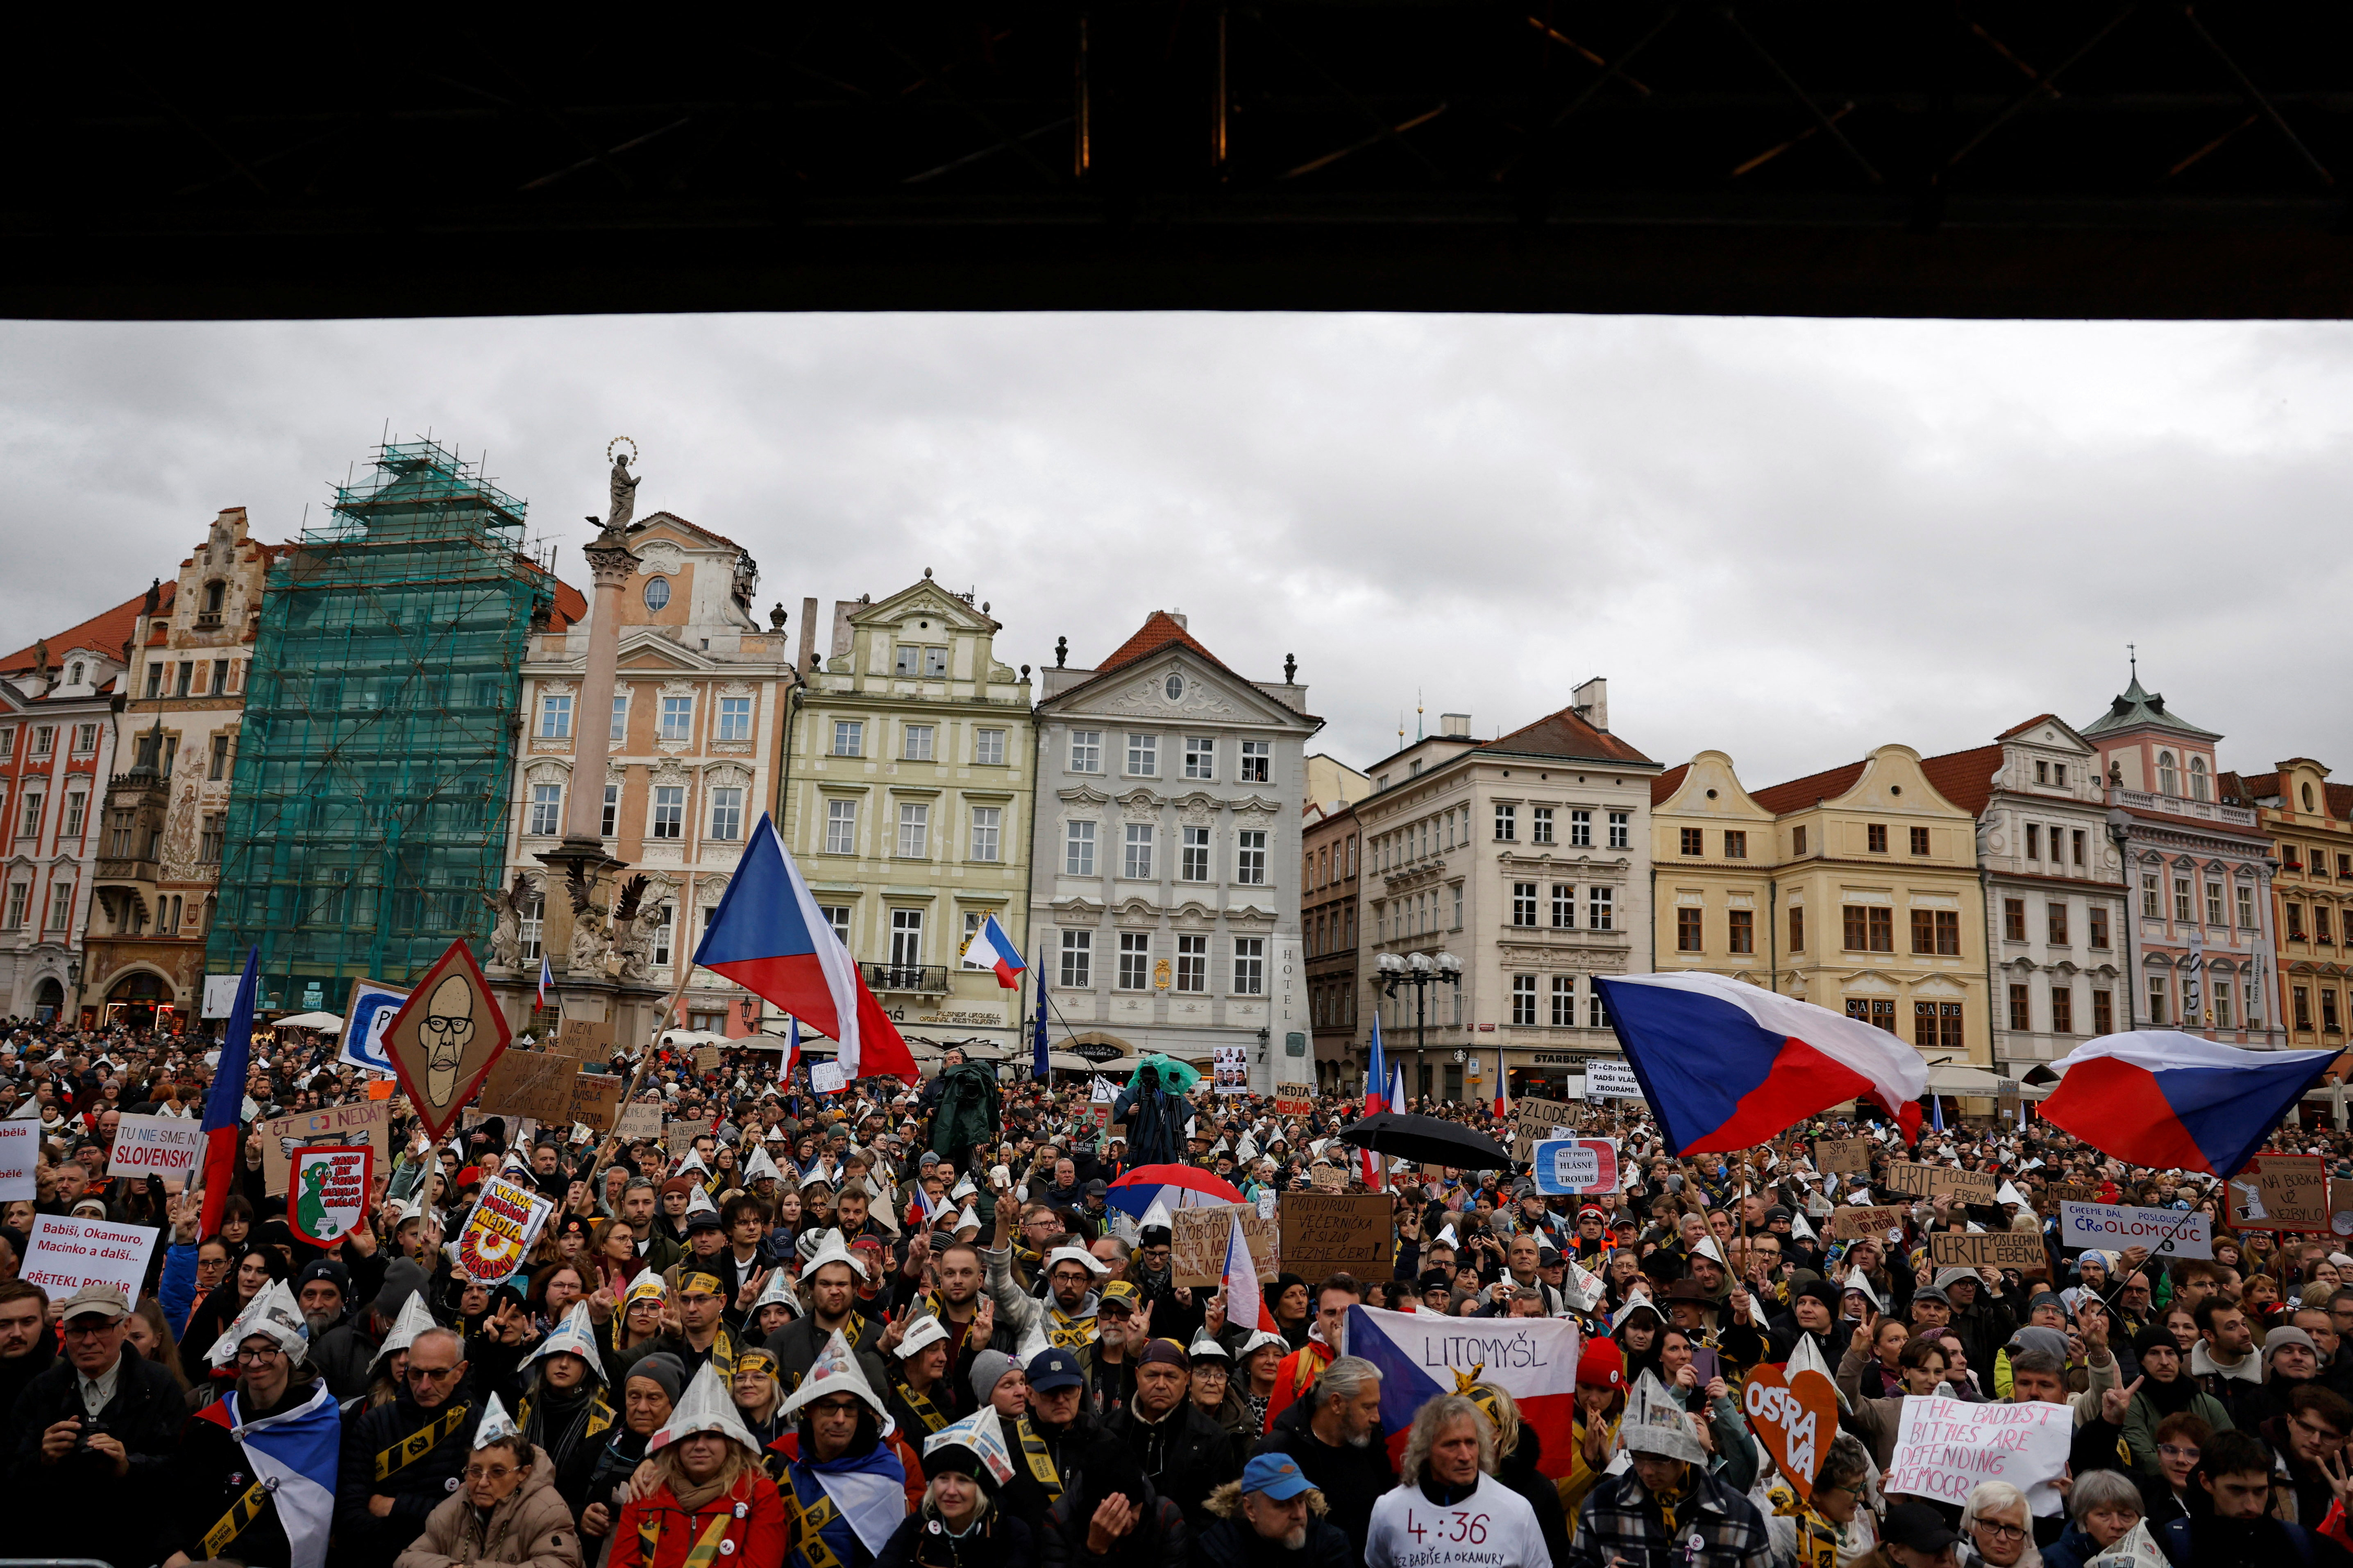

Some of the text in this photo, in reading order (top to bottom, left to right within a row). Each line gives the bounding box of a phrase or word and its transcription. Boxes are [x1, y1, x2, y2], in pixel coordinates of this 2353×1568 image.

[1284, 949, 1292, 1020] HOTEL
[1847, 1000, 1893, 1013] CAFE
[1915, 1004, 1960, 1016] CAFE
[570, 1022, 596, 1036] NENÍ
[506, 1052, 533, 1072] STOP
[814, 1063, 840, 1076] MÉDIA
[512, 1074, 563, 1091] AROGANCE
[591, 1078, 615, 1090] 404
[816, 1083, 824, 1092] NE
[1277, 1082, 1311, 1097] MÉDIA
[1596, 1085, 1637, 1094] ZBOURÁME!
[1276, 1097, 1310, 1115] NEDÁME
[1523, 1101, 1577, 1126] ZLODĚJ
[120, 1126, 184, 1144] TU NIE SME
[272, 1119, 295, 1137] ČT
[617, 1123, 638, 1132] DOBRO
[1829, 1142, 1848, 1155] SPD
[334, 1166, 352, 1176] BY
[1560, 1160, 1593, 1169] HLÁSNÉ
[330, 1175, 362, 1186] TOHO
[1313, 1171, 1349, 1186] NEDÁME
[1391, 1173, 1407, 1185] ČT
[1559, 1174, 1595, 1183] TROUBĚ
[1888, 1160, 1994, 1197] ČERTE POSLECHNI
[2263, 1173, 2322, 1190] NA BOBKA
[494, 1185, 534, 1210] VLÁDA
[1954, 1188, 1992, 1204] EBENA
[2051, 1184, 2094, 1201] MÉDIA
[2280, 1190, 2297, 1204] UŽ
[323, 1195, 362, 1208] MÁLO!
[483, 1194, 532, 1226] OKRÁDÁ
[1173, 1207, 1229, 1226] KDO SAHÁ
[1298, 1214, 1372, 1230] VEČERNÍČKA
[2069, 1205, 2198, 1226] CHCEME DÁL POSLOUCHAT
[2269, 1208, 2324, 1221] NEZBYLO
[473, 1207, 522, 1242] MÉDIA
[1174, 1224, 1230, 1242] SVOBODU
[2105, 1221, 2201, 1242] OLOMOUC
[42, 1222, 144, 1246] Babiši, Okamuro,
[1328, 1231, 1350, 1243] ZLO
[1988, 1233, 2040, 1247] POSLECHNI
[37, 1240, 86, 1255] Macinko
[89, 1247, 96, 1257] a
[1173, 1241, 1203, 1258] TOHO
[1291, 1245, 1332, 1260] VEZME
[1997, 1247, 2046, 1264] EBENA
[1174, 1260, 1223, 1277] POŽENE
[26, 1269, 78, 1288] PŘETEKL
[1579, 1273, 1594, 1289] DNES
[1426, 1330, 1547, 1369] LITOMYŠL
[1911, 1399, 2059, 1426] THE BADDEST
[1987, 1429, 2033, 1452] ARE
[1900, 1443, 2007, 1475] DEFENDING
[1408, 1508, 1491, 1545] 4:36
[211, 1541, 219, 1549] OD
[1409, 1546, 1441, 1568] BABIŠE
[1444, 1551, 1451, 1564] A
[1454, 1551, 1504, 1566] OKAMURY
